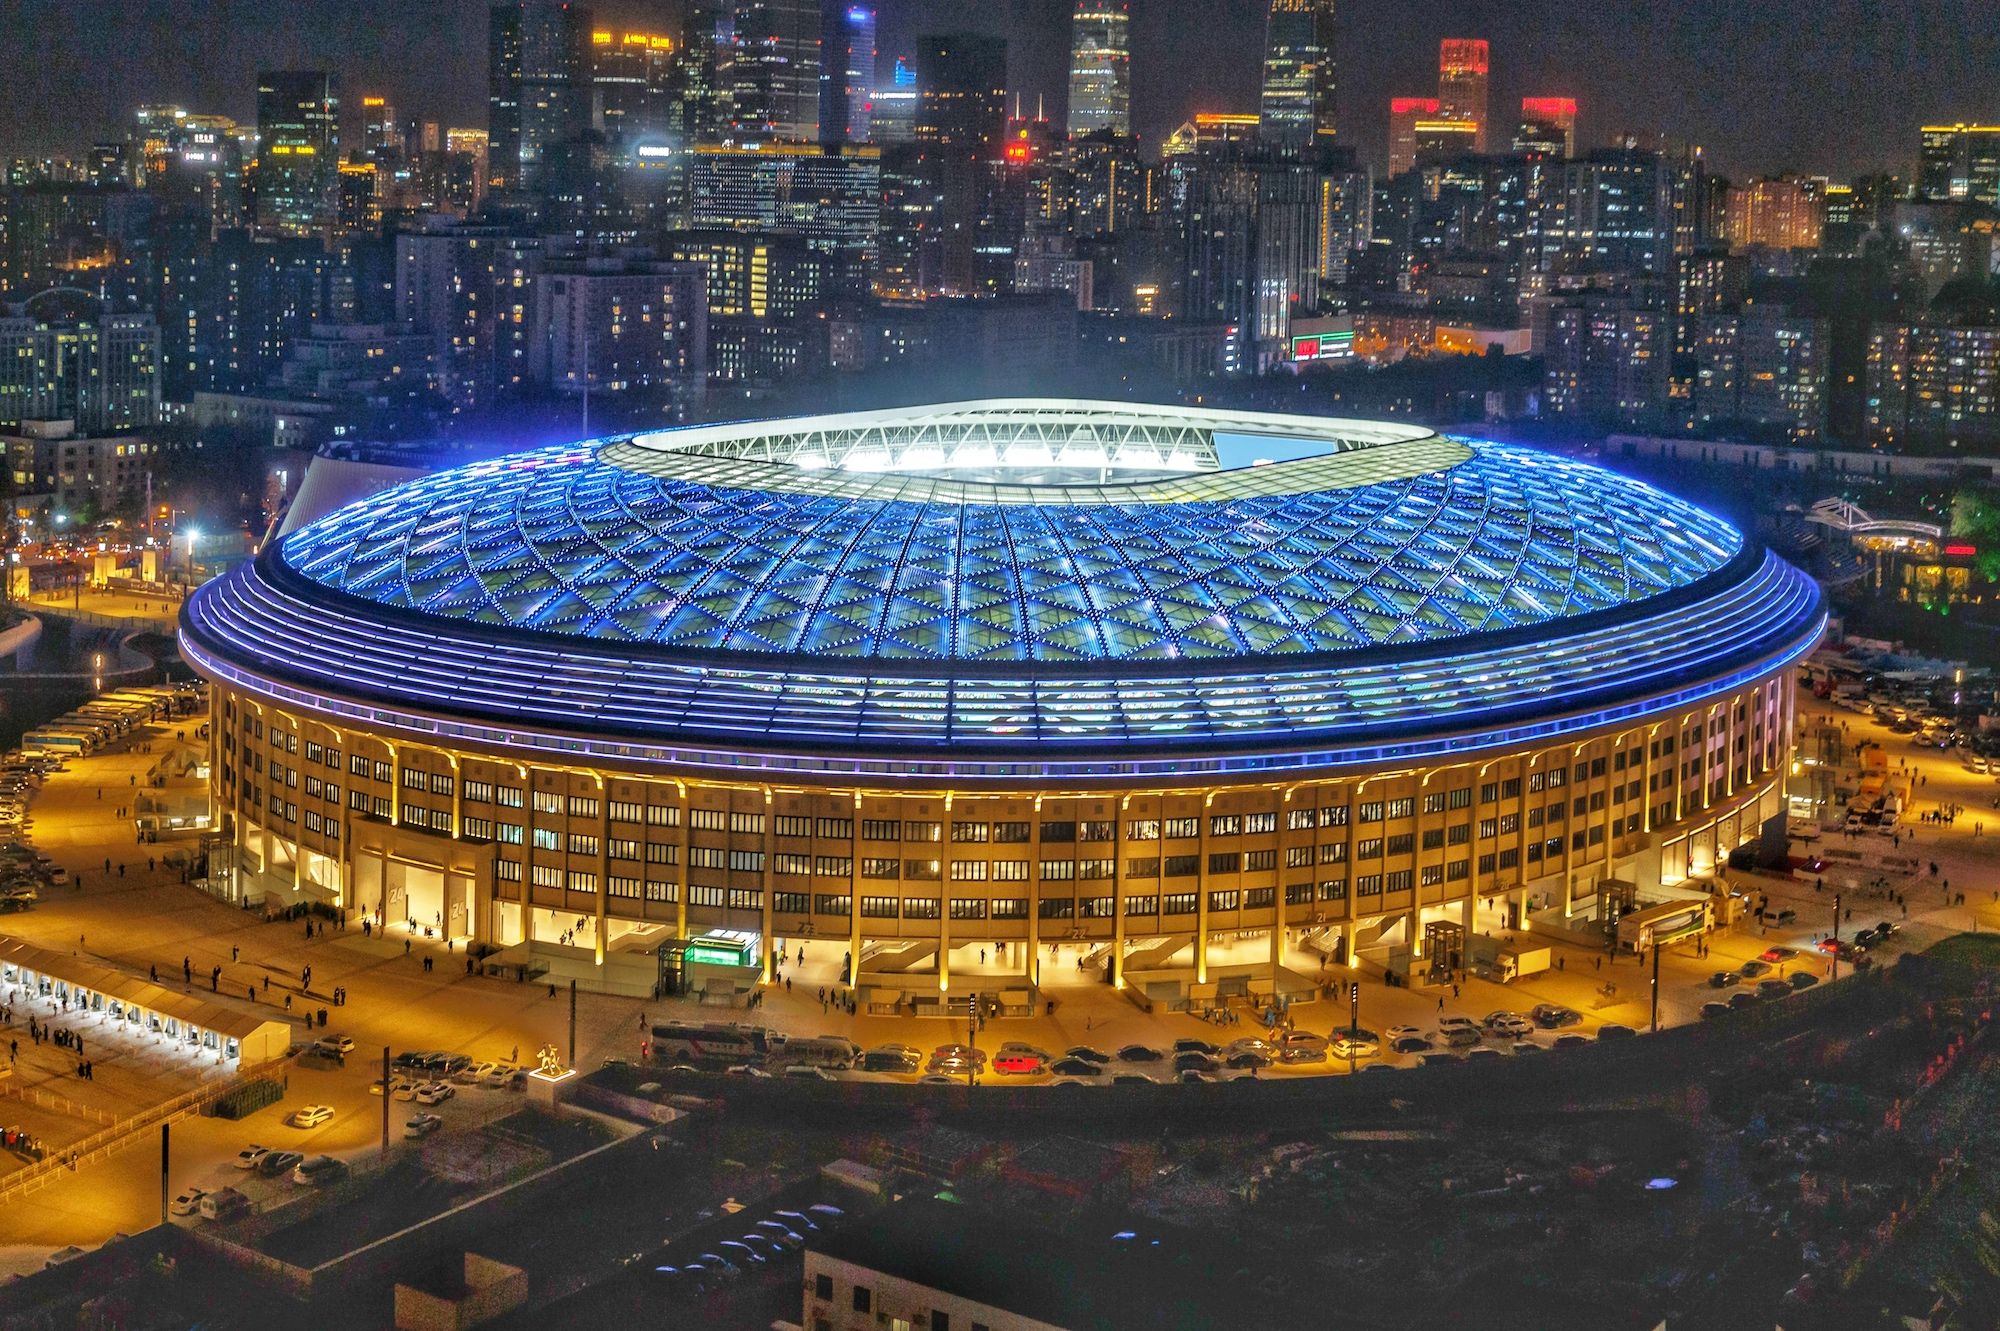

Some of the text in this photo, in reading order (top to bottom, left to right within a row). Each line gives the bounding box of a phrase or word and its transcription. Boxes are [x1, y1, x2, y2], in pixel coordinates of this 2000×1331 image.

[389, 887, 403, 903] 24
[452, 902, 464, 918] 24
[1317, 912, 1326, 922] 21
